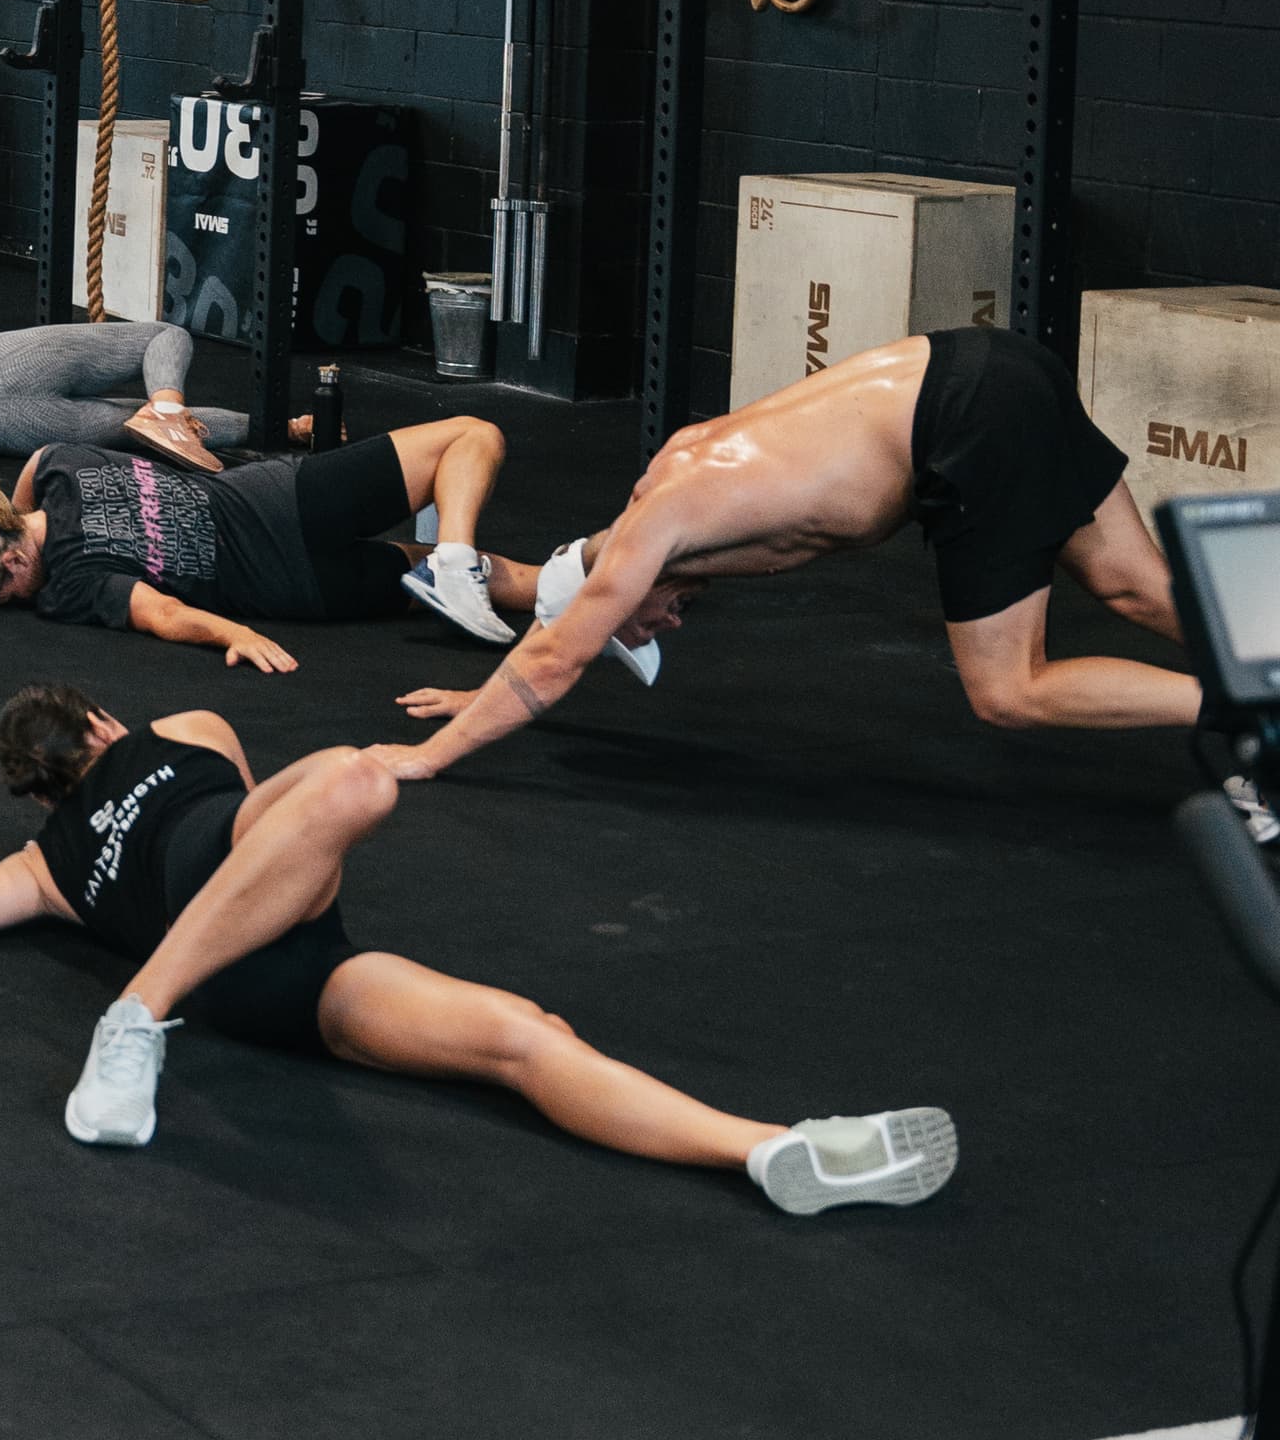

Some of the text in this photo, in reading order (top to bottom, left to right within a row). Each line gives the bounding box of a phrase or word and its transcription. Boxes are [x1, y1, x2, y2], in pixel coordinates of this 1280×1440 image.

[195, 213, 229, 235] SMAI
[760, 198, 774, 231] 24"
[806, 280, 830, 377] SMA
[1146, 421, 1248, 473] SMAI
[130, 457, 167, 542] STRENGTH
